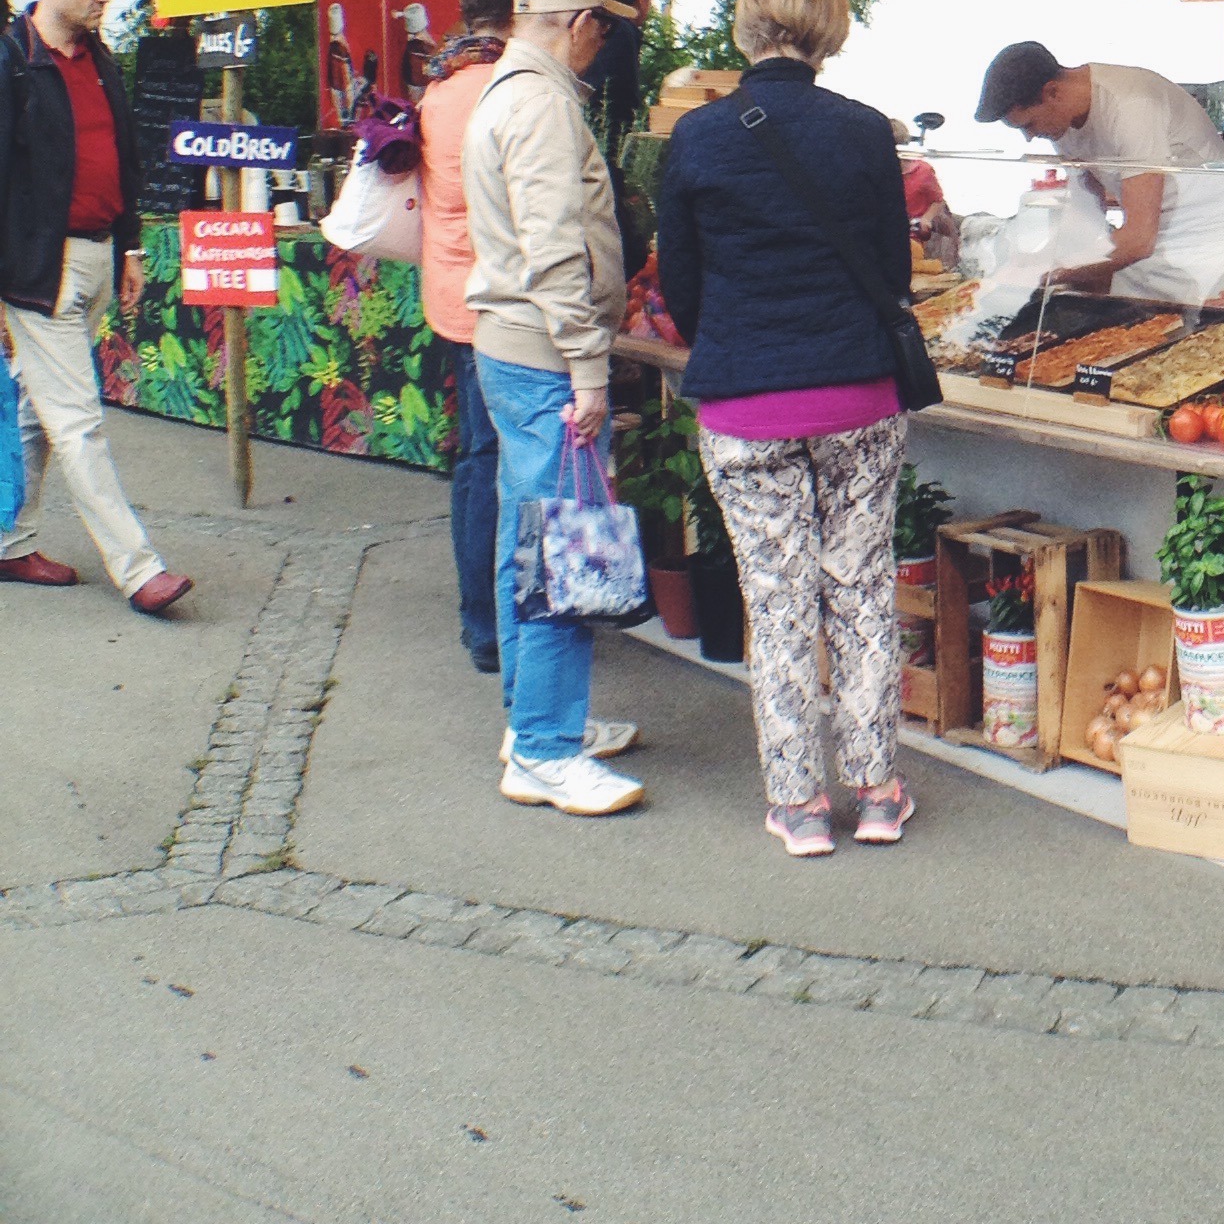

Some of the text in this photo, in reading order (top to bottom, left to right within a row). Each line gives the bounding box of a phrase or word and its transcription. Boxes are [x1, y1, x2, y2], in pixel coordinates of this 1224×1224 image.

[197, 31, 234, 54] ALLES
[194, 221, 265, 237] CASCARA
[208, 269, 246, 289] TEE
